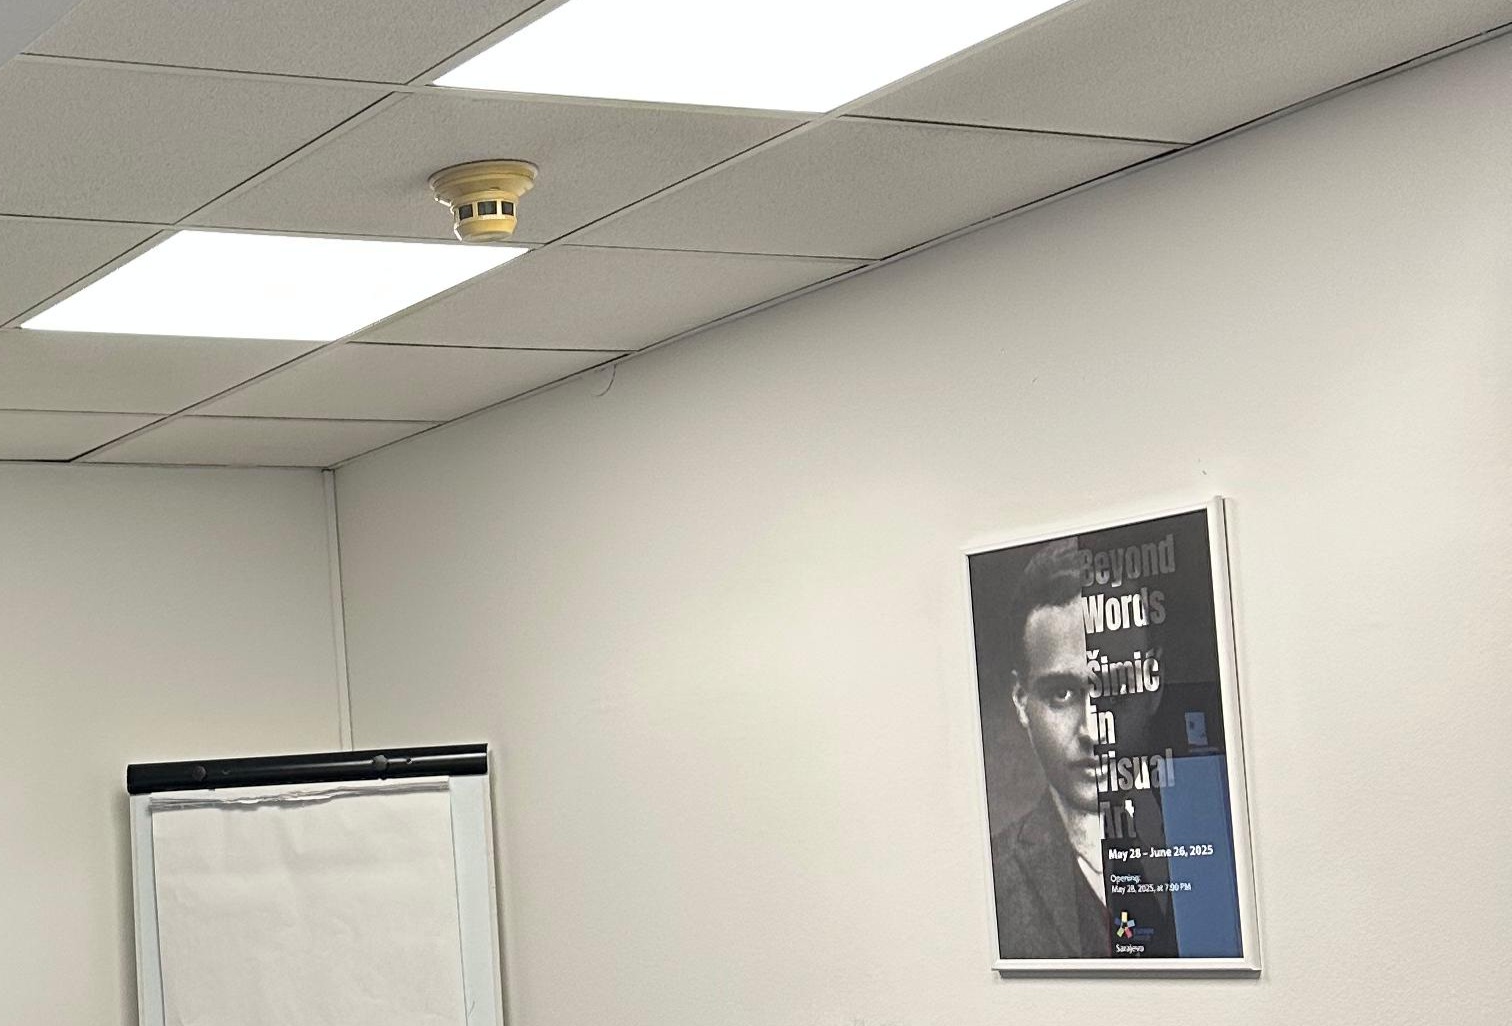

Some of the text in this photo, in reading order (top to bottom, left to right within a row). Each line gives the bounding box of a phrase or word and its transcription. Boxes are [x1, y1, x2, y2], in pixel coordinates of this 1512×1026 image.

[1078, 533, 1176, 588] Beyond
[1081, 587, 1166, 634] Words
[1086, 648, 1160, 698] Šimić
[1089, 705, 1116, 745] in
[1094, 748, 1175, 792] Visual
[1099, 799, 1137, 839] Art
[1108, 849, 1128, 861] May
[1129, 848, 1142, 859] 28
[1149, 847, 1172, 858] June
[1173, 846, 1188, 858] 26,
[1189, 845, 1214, 856] 2025
[1111, 885, 1126, 895] May
